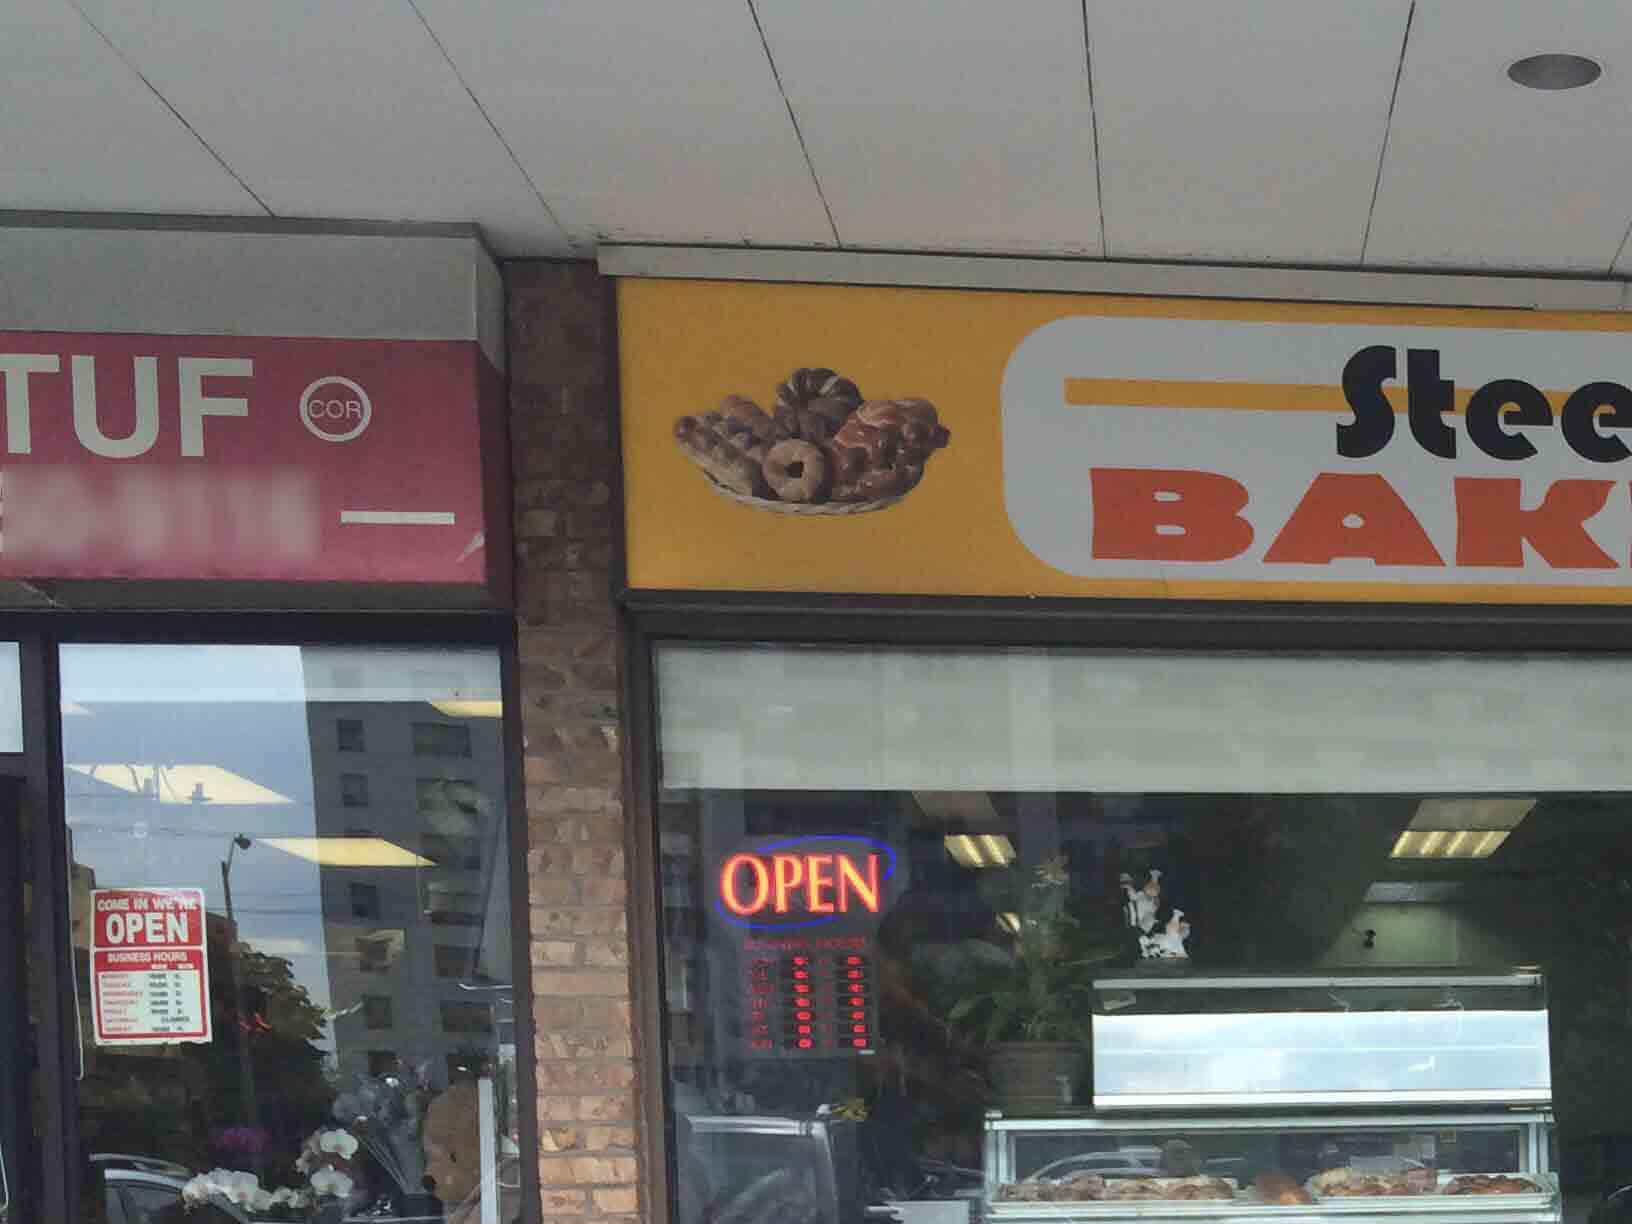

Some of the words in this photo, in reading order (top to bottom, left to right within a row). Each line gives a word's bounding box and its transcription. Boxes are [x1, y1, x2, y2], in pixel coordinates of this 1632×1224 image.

[308, 399, 361, 419] COR
[720, 852, 882, 916] OPEN
[97, 898, 129, 912] COME
[134, 897, 149, 911] IN
[105, 912, 189, 944] OPEN
